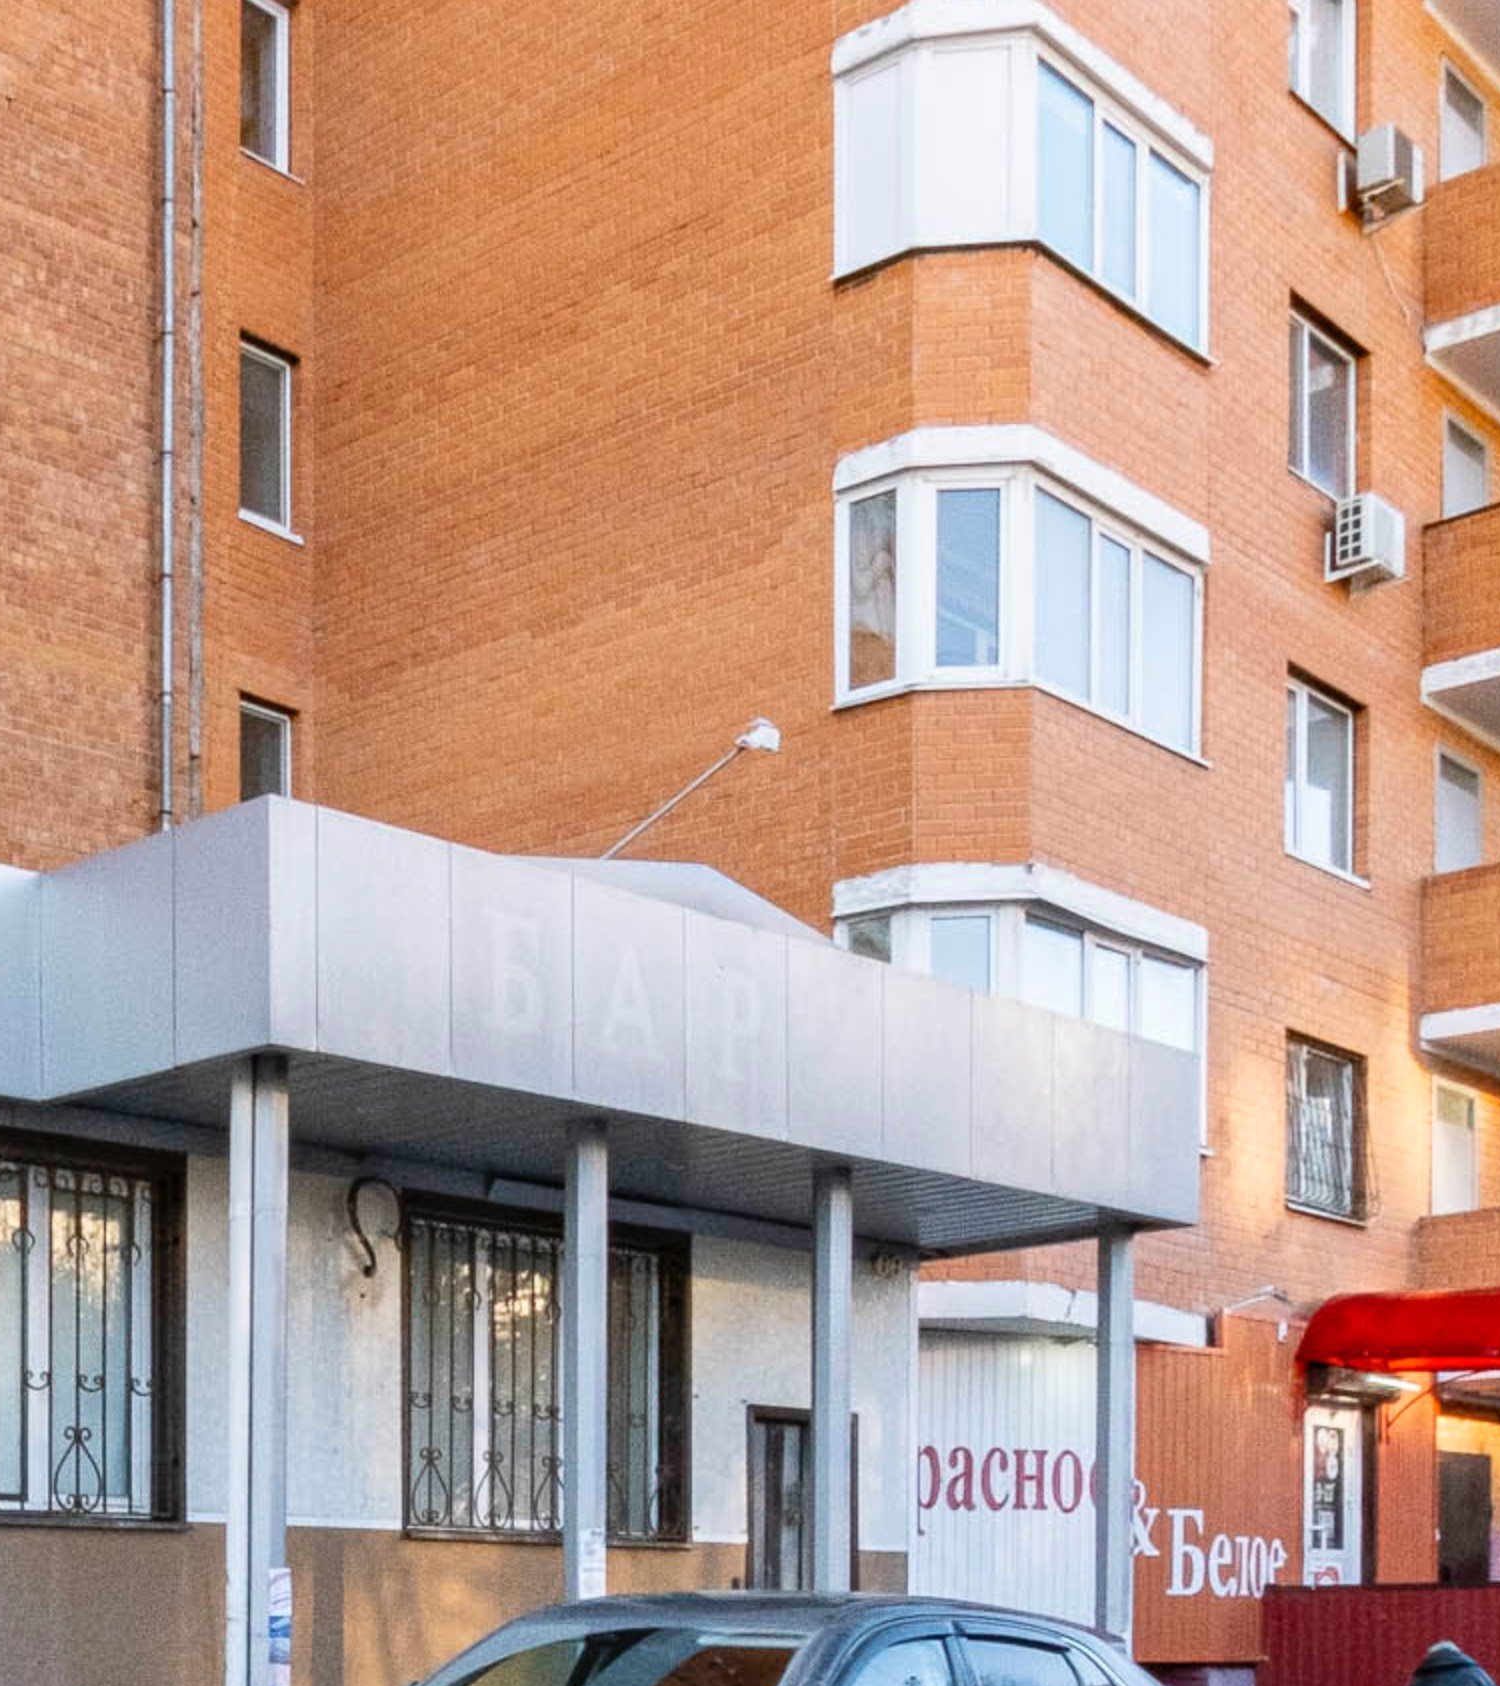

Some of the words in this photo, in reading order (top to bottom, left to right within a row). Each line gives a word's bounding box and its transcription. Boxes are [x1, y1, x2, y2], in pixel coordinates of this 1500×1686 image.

[481, 906, 761, 1082] БАР
[917, 1445, 1097, 1535] расно
[1165, 1508, 1288, 1598] Белое
